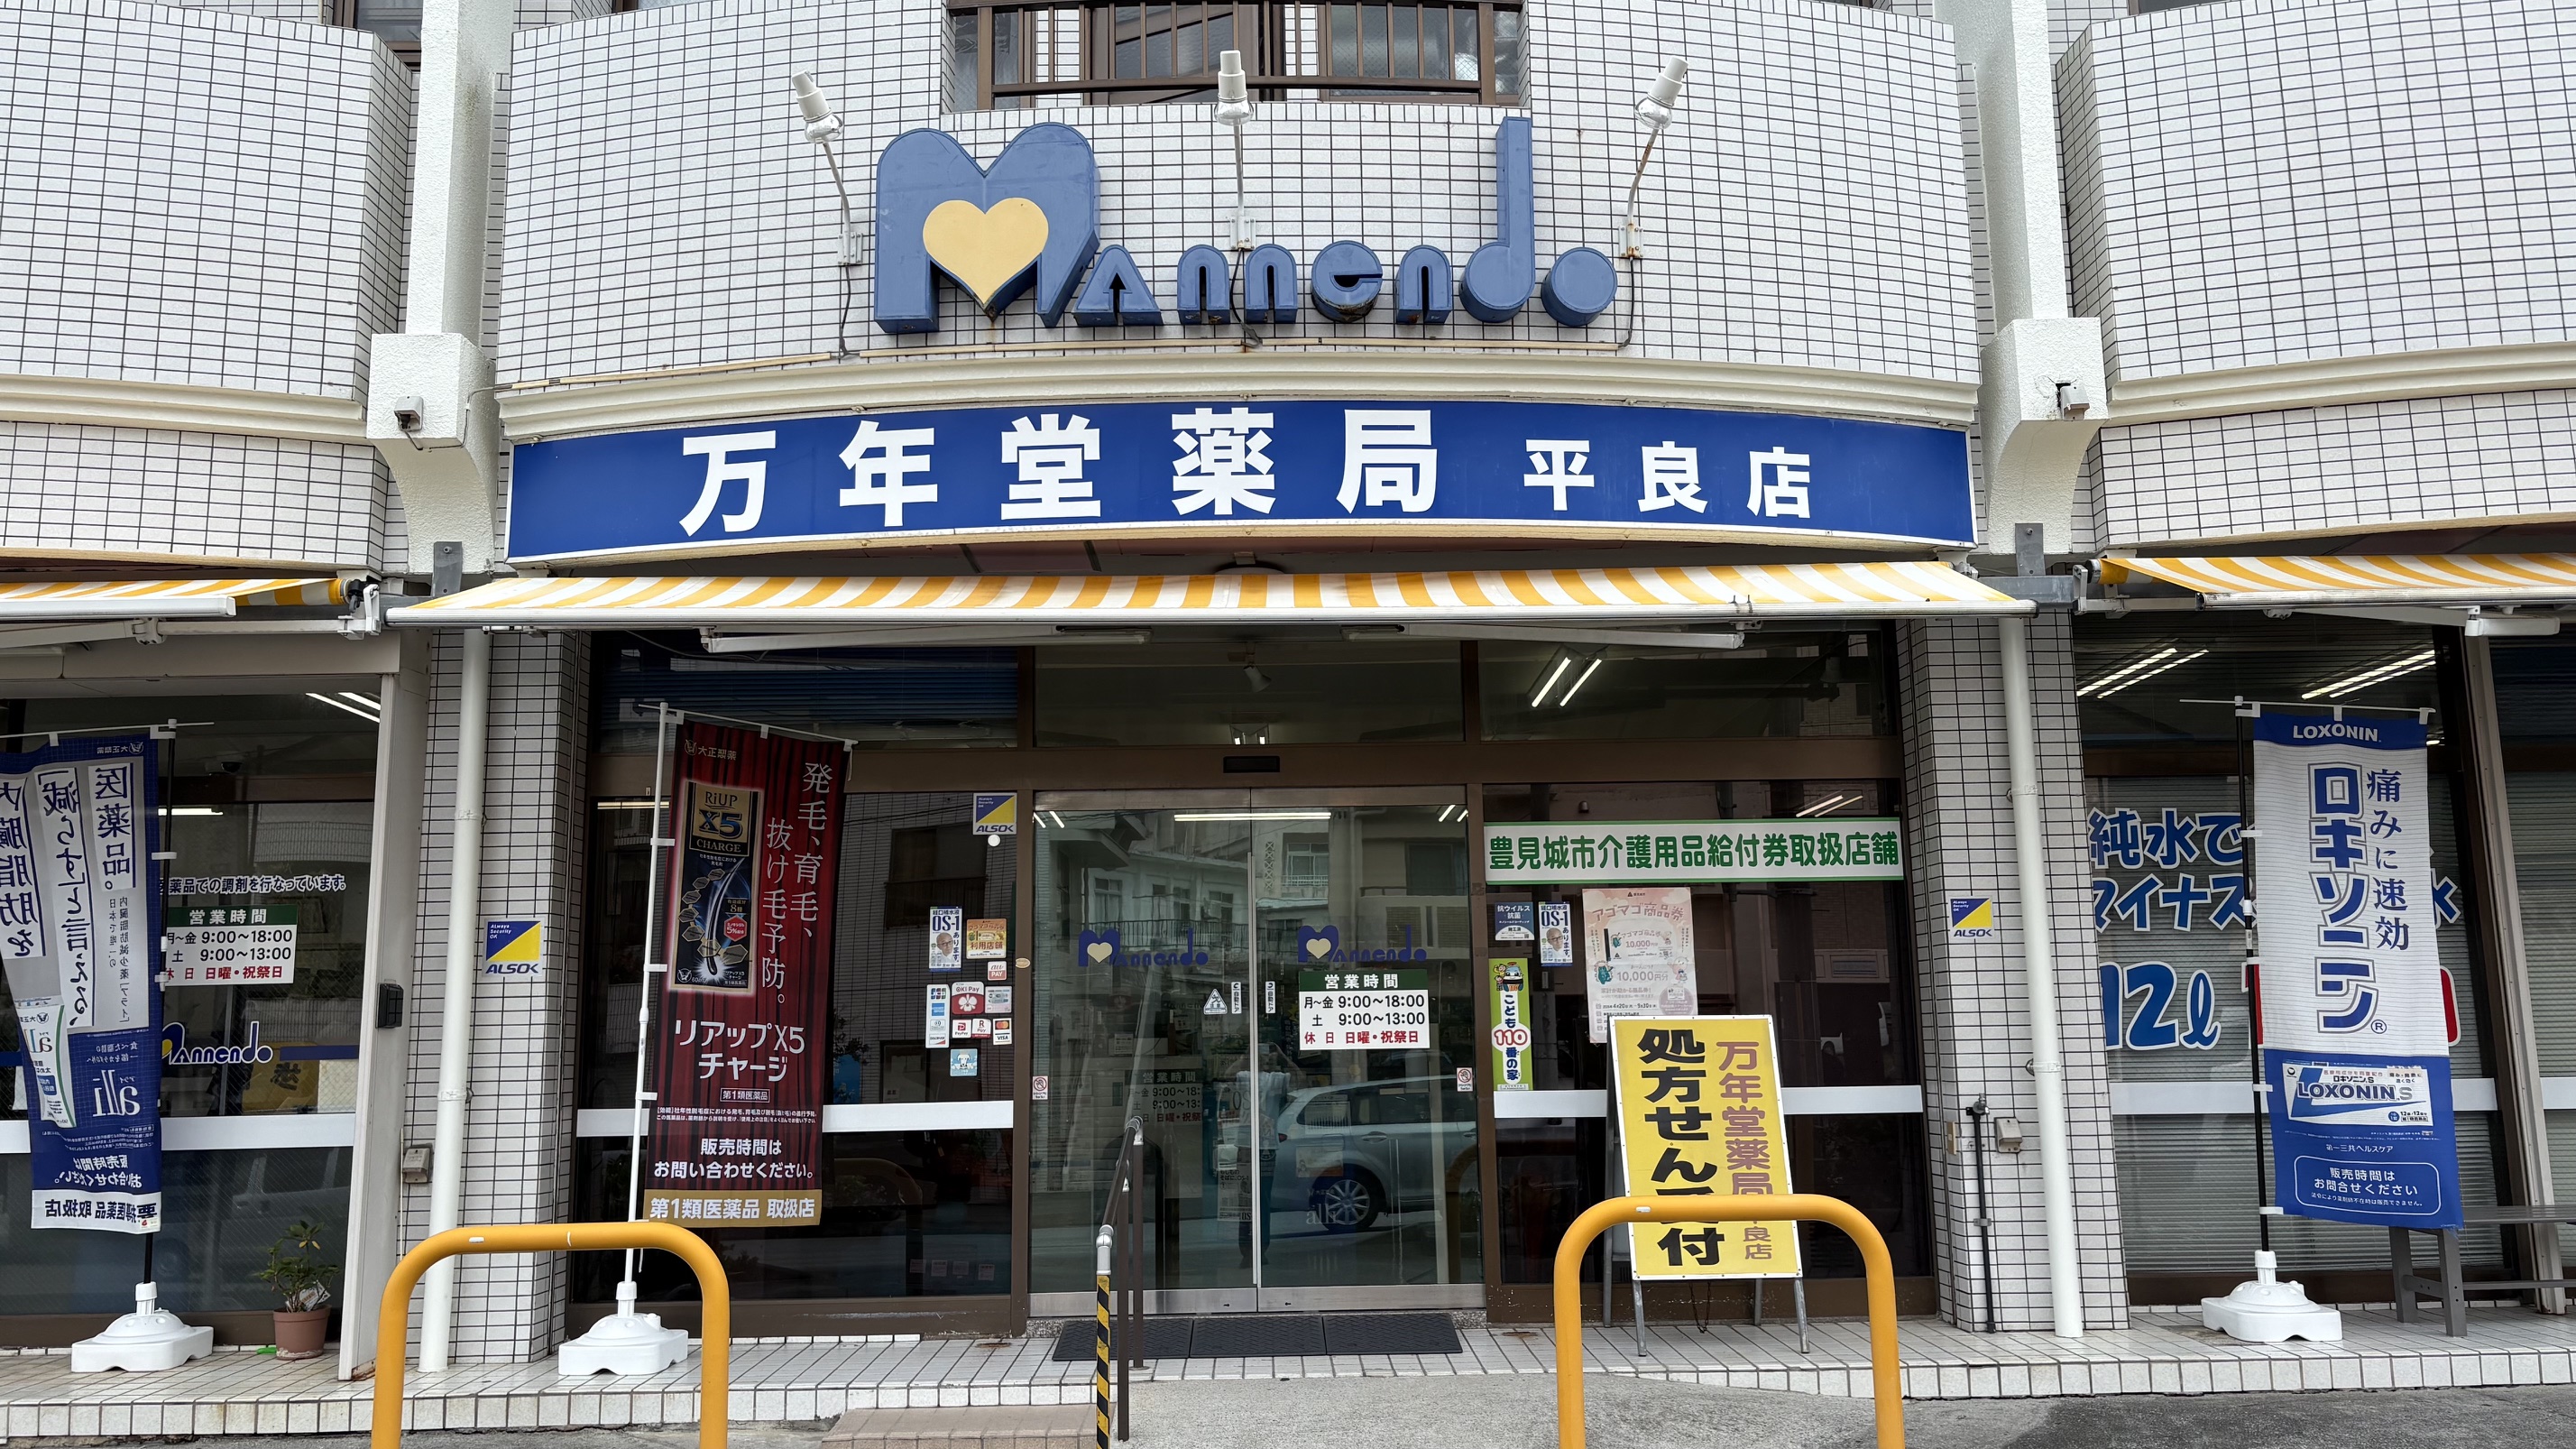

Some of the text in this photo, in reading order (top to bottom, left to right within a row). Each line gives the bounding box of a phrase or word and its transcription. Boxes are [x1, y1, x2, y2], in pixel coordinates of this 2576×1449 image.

[679, 408, 1810, 536] 万年堂薬局 平良店
[2292, 724, 2378, 742] LOXONIN
[698, 745, 737, 761] 大正製薬
[976, 825, 1014, 833] ALSOK
[696, 839, 741, 853] CHARGE
[790, 762, 833, 937] 発毛、育毛、
[1489, 831, 1900, 871] 豊見城市介護用品給付券取扱店舗
[2366, 768, 2410, 951] 痛みに速効
[2308, 763, 2378, 1032] ロキソニン
[189, 909, 267, 926] 営業時間
[761, 817, 794, 1004] 抜け毛予防。
[1541, 911, 1569, 927] OS-1
[1592, 902, 1684, 921] アゴマゴ商品券
[932, 916, 960, 931] OS-1
[1954, 929, 1992, 937] ALSOK
[171, 950, 183, 963] 土
[485, 964, 539, 974] ALSOK
[1324, 974, 1398, 989] 営業時間
[1311, 1014, 1323, 1027] 土
[675, 1020, 805, 1054] リアップX5
[1346, 1030, 1419, 1044] 日曜・祝祭日
[699, 1052, 787, 1082] チャージ
[1143, 1071, 1196, 1083] 営業時間
[722, 1090, 768, 1101] 第1類医薬品
[701, 1138, 782, 1156] 販売時間は
[2325, 1144, 2393, 1153] 第一三共ヘルスケア
[654, 1161, 814, 1179] お問い合わせください。
[2329, 1167, 2396, 1182] 販売時間は
[2314, 1178, 2418, 1195] お問合せください
[649, 1198, 815, 1220] 第1類医薬品 取扱店
[1743, 1221, 1772, 1260] 良店
